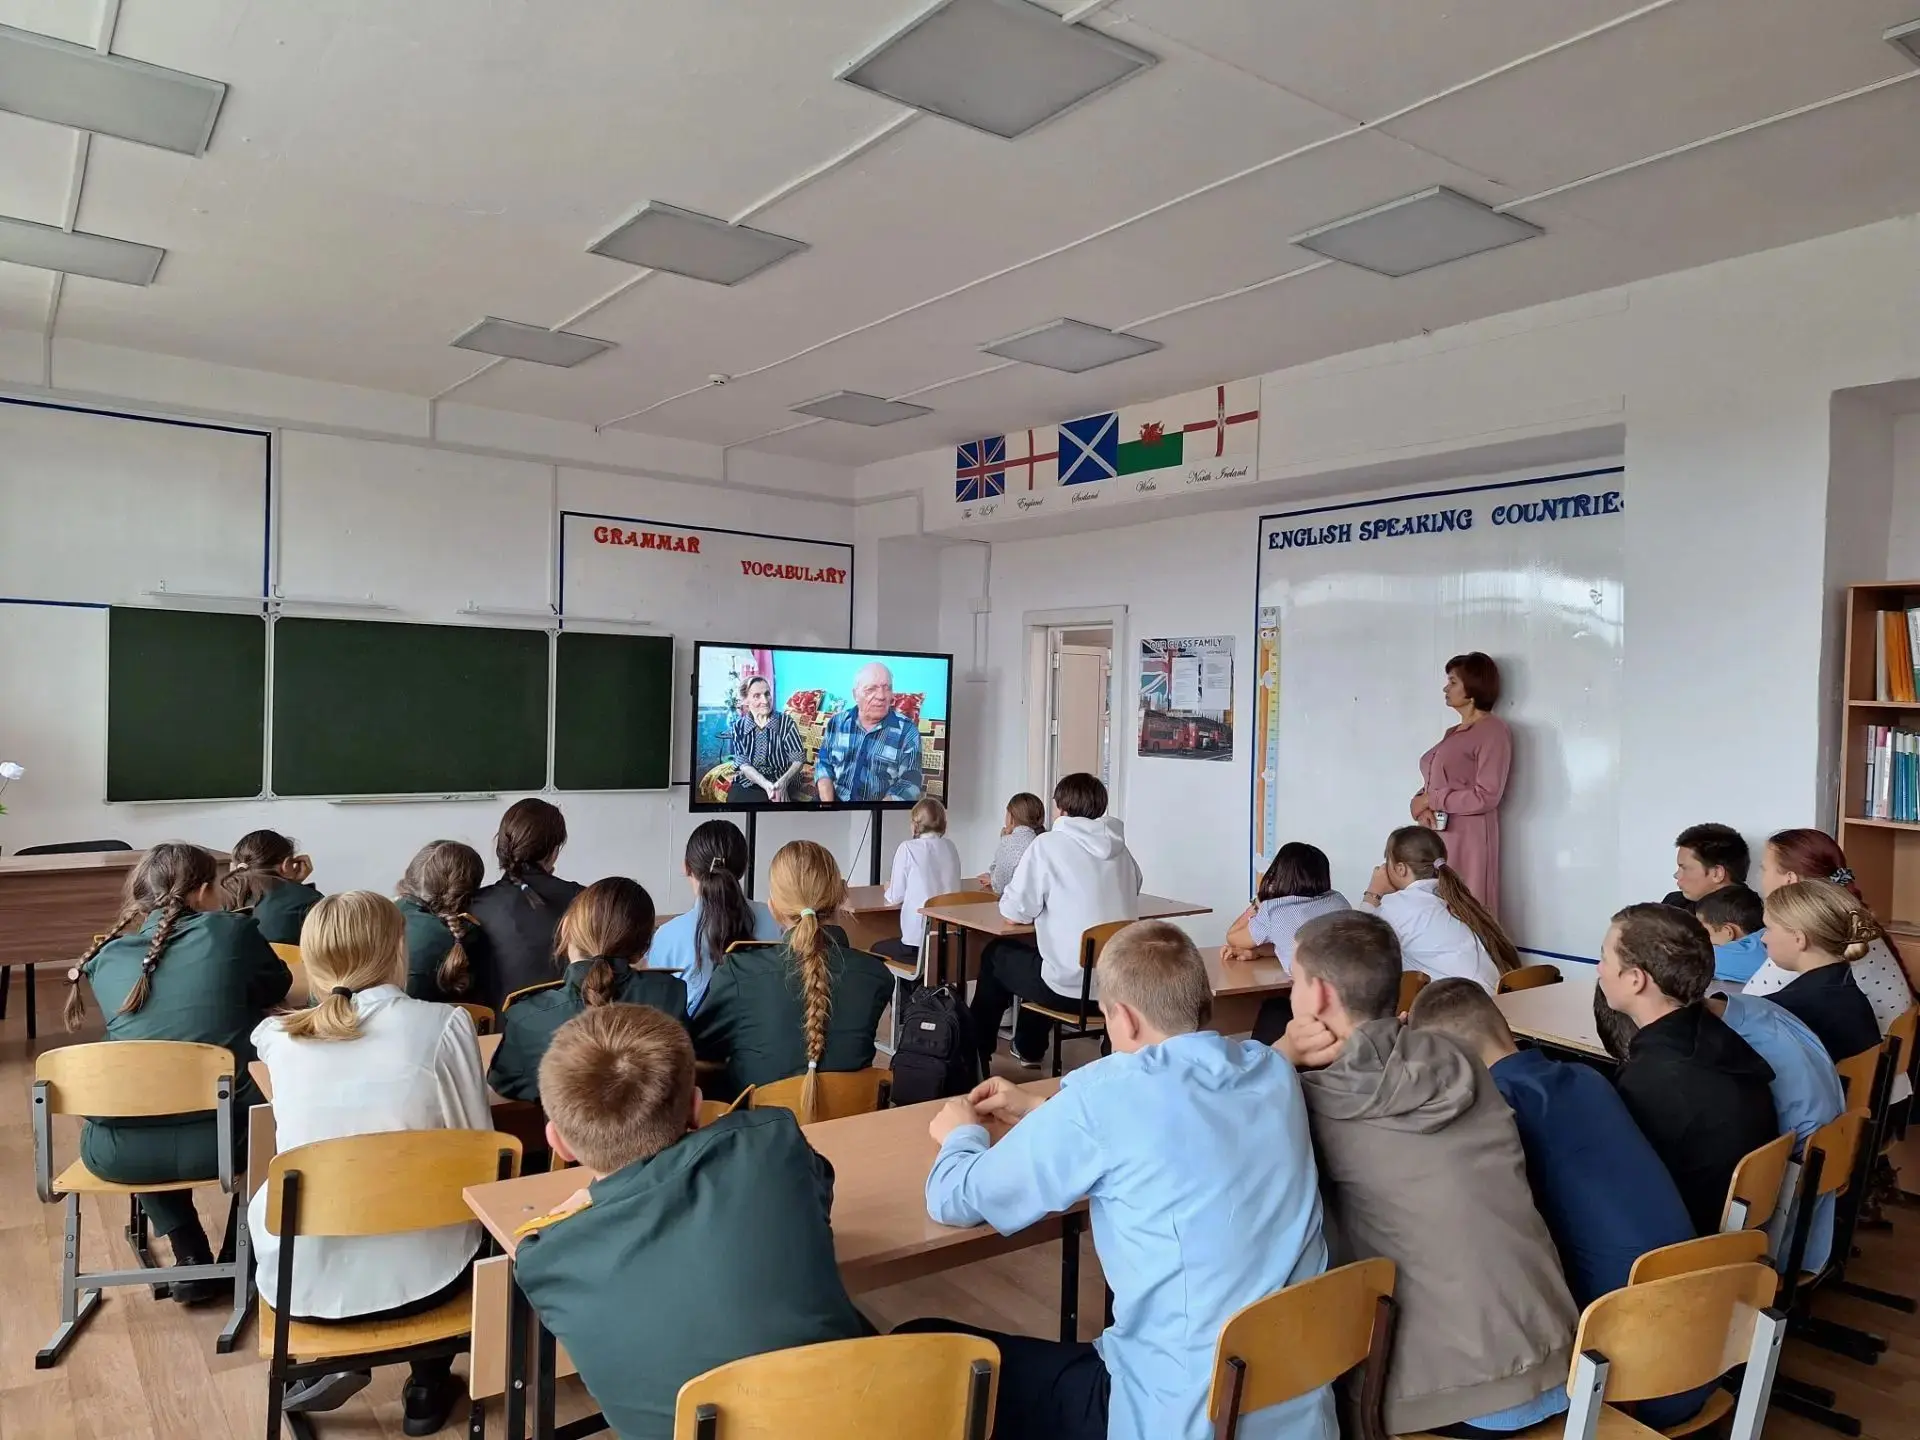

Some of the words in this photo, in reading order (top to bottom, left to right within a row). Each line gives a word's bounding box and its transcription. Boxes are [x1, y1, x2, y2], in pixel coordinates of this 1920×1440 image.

[1186, 470, 1212, 485] North
[1216, 466, 1248, 480] Ireland
[1136, 478, 1157, 492] Wales
[1017, 497, 1044, 511] England
[1071, 490, 1100, 504] Scotland
[1268, 523, 1352, 549] ENGLISH
[1359, 509, 1472, 541] SPEAKING
[1491, 491, 1625, 525] COUNTRIE
[594, 526, 700, 553] GRAMMAR
[740, 560, 846, 584] VOCABULARY
[1169, 640, 1192, 649] CLASS
[1194, 638, 1222, 648] FAMILY
